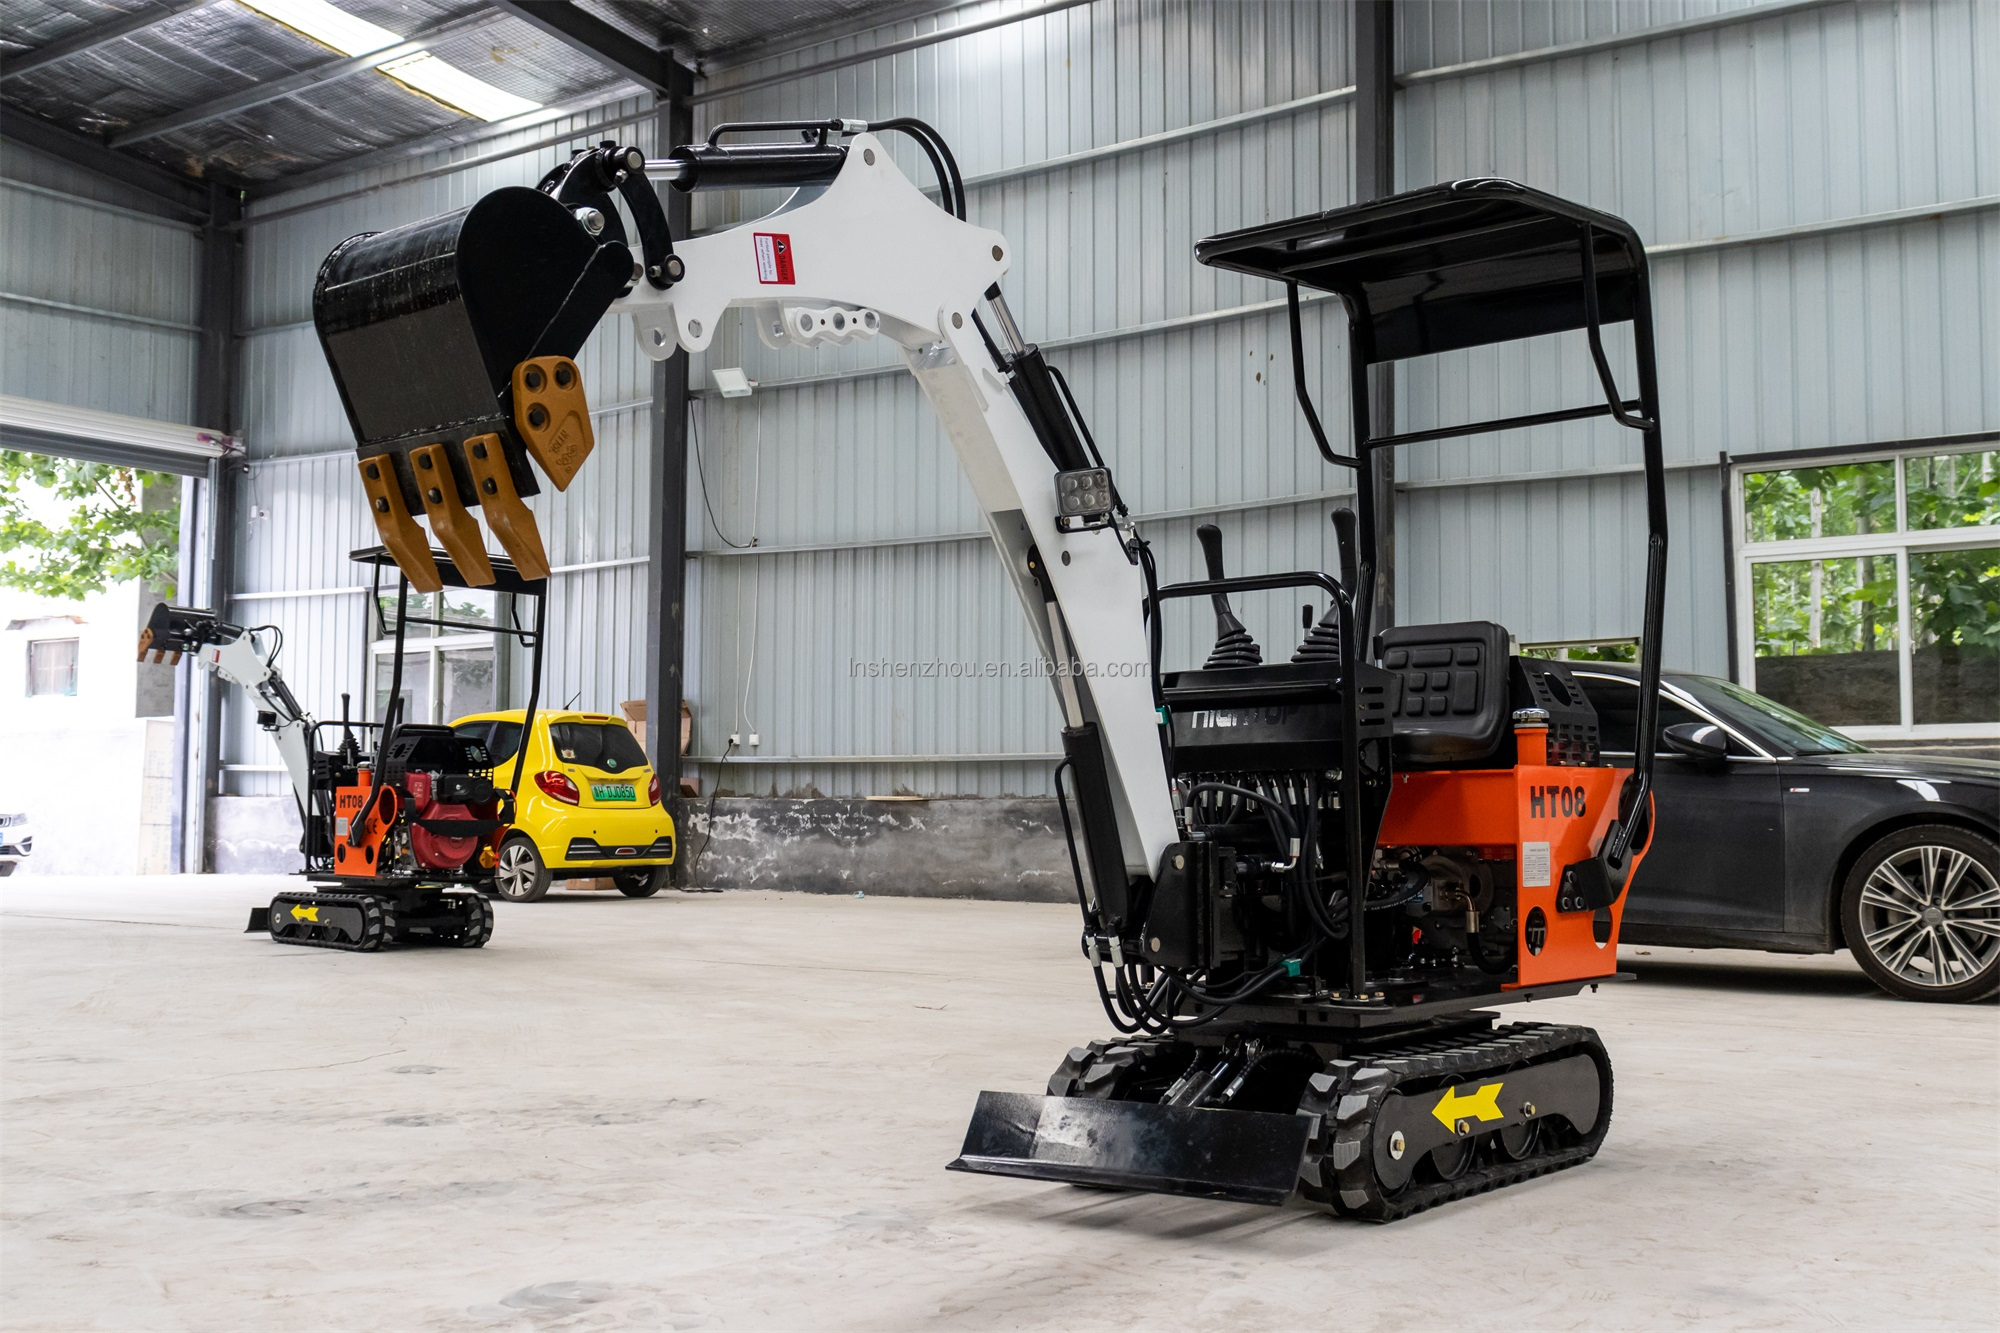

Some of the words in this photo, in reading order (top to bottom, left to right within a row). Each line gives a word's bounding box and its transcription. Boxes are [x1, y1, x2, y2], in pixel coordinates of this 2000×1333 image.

[780, 256, 788, 280] DANGER
[339, 795, 363, 808] HT08
[1530, 785, 1586, 818] HT08
